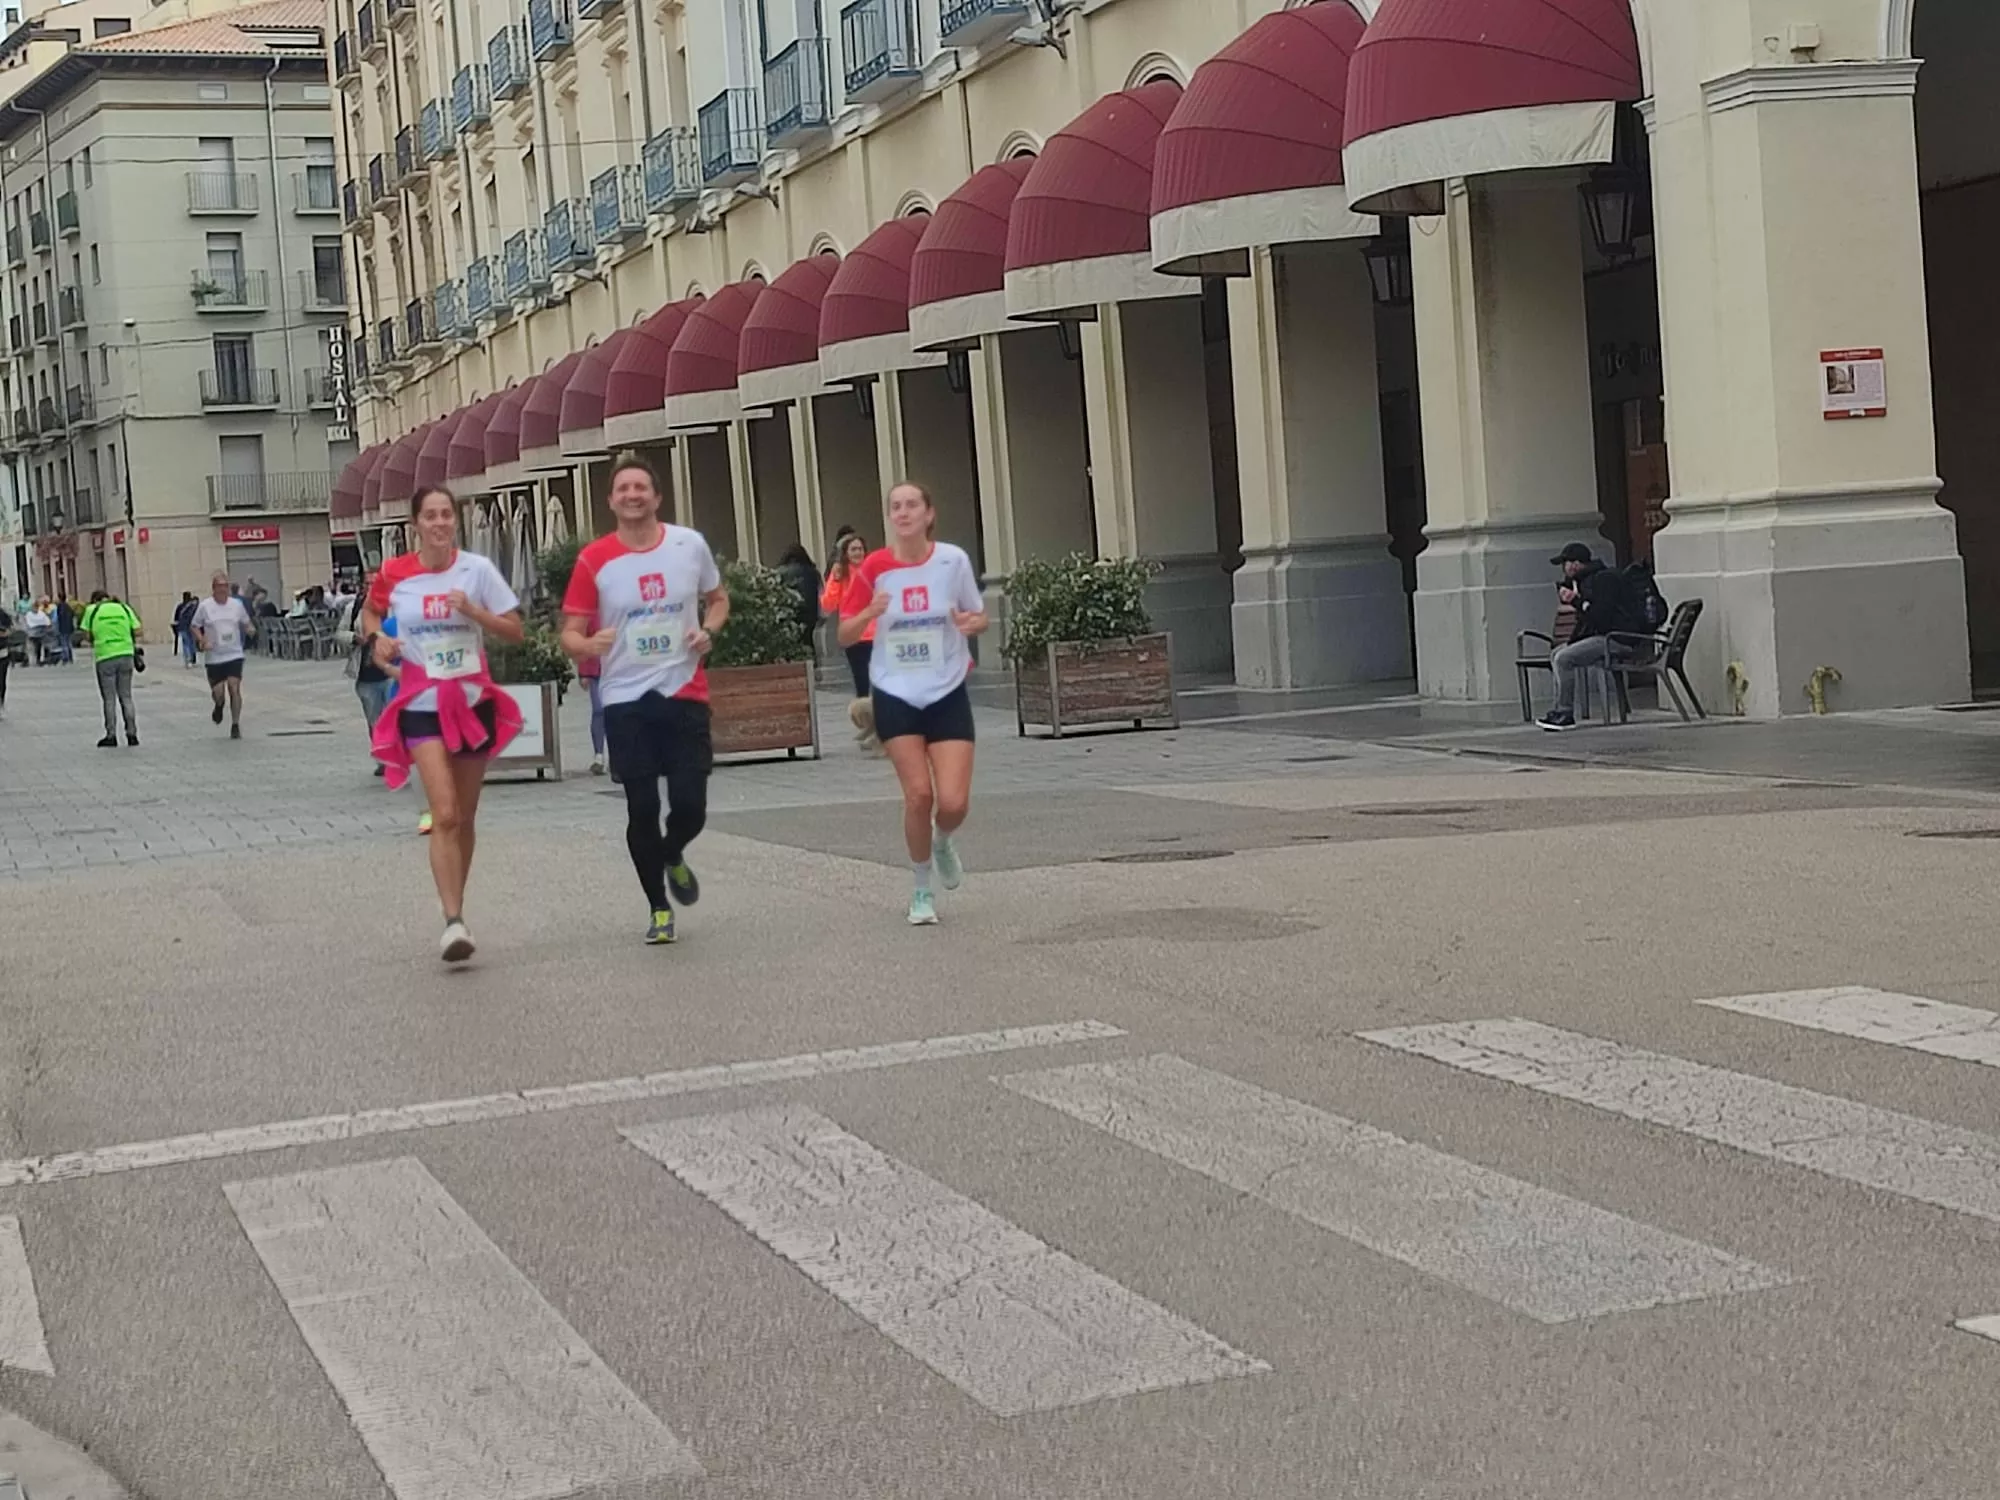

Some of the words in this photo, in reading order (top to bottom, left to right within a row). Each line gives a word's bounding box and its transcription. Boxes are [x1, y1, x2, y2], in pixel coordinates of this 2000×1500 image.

[328, 326, 348, 422] HOSTAL
[237, 528, 265, 540] GAES
[435, 648, 465, 667] 387
